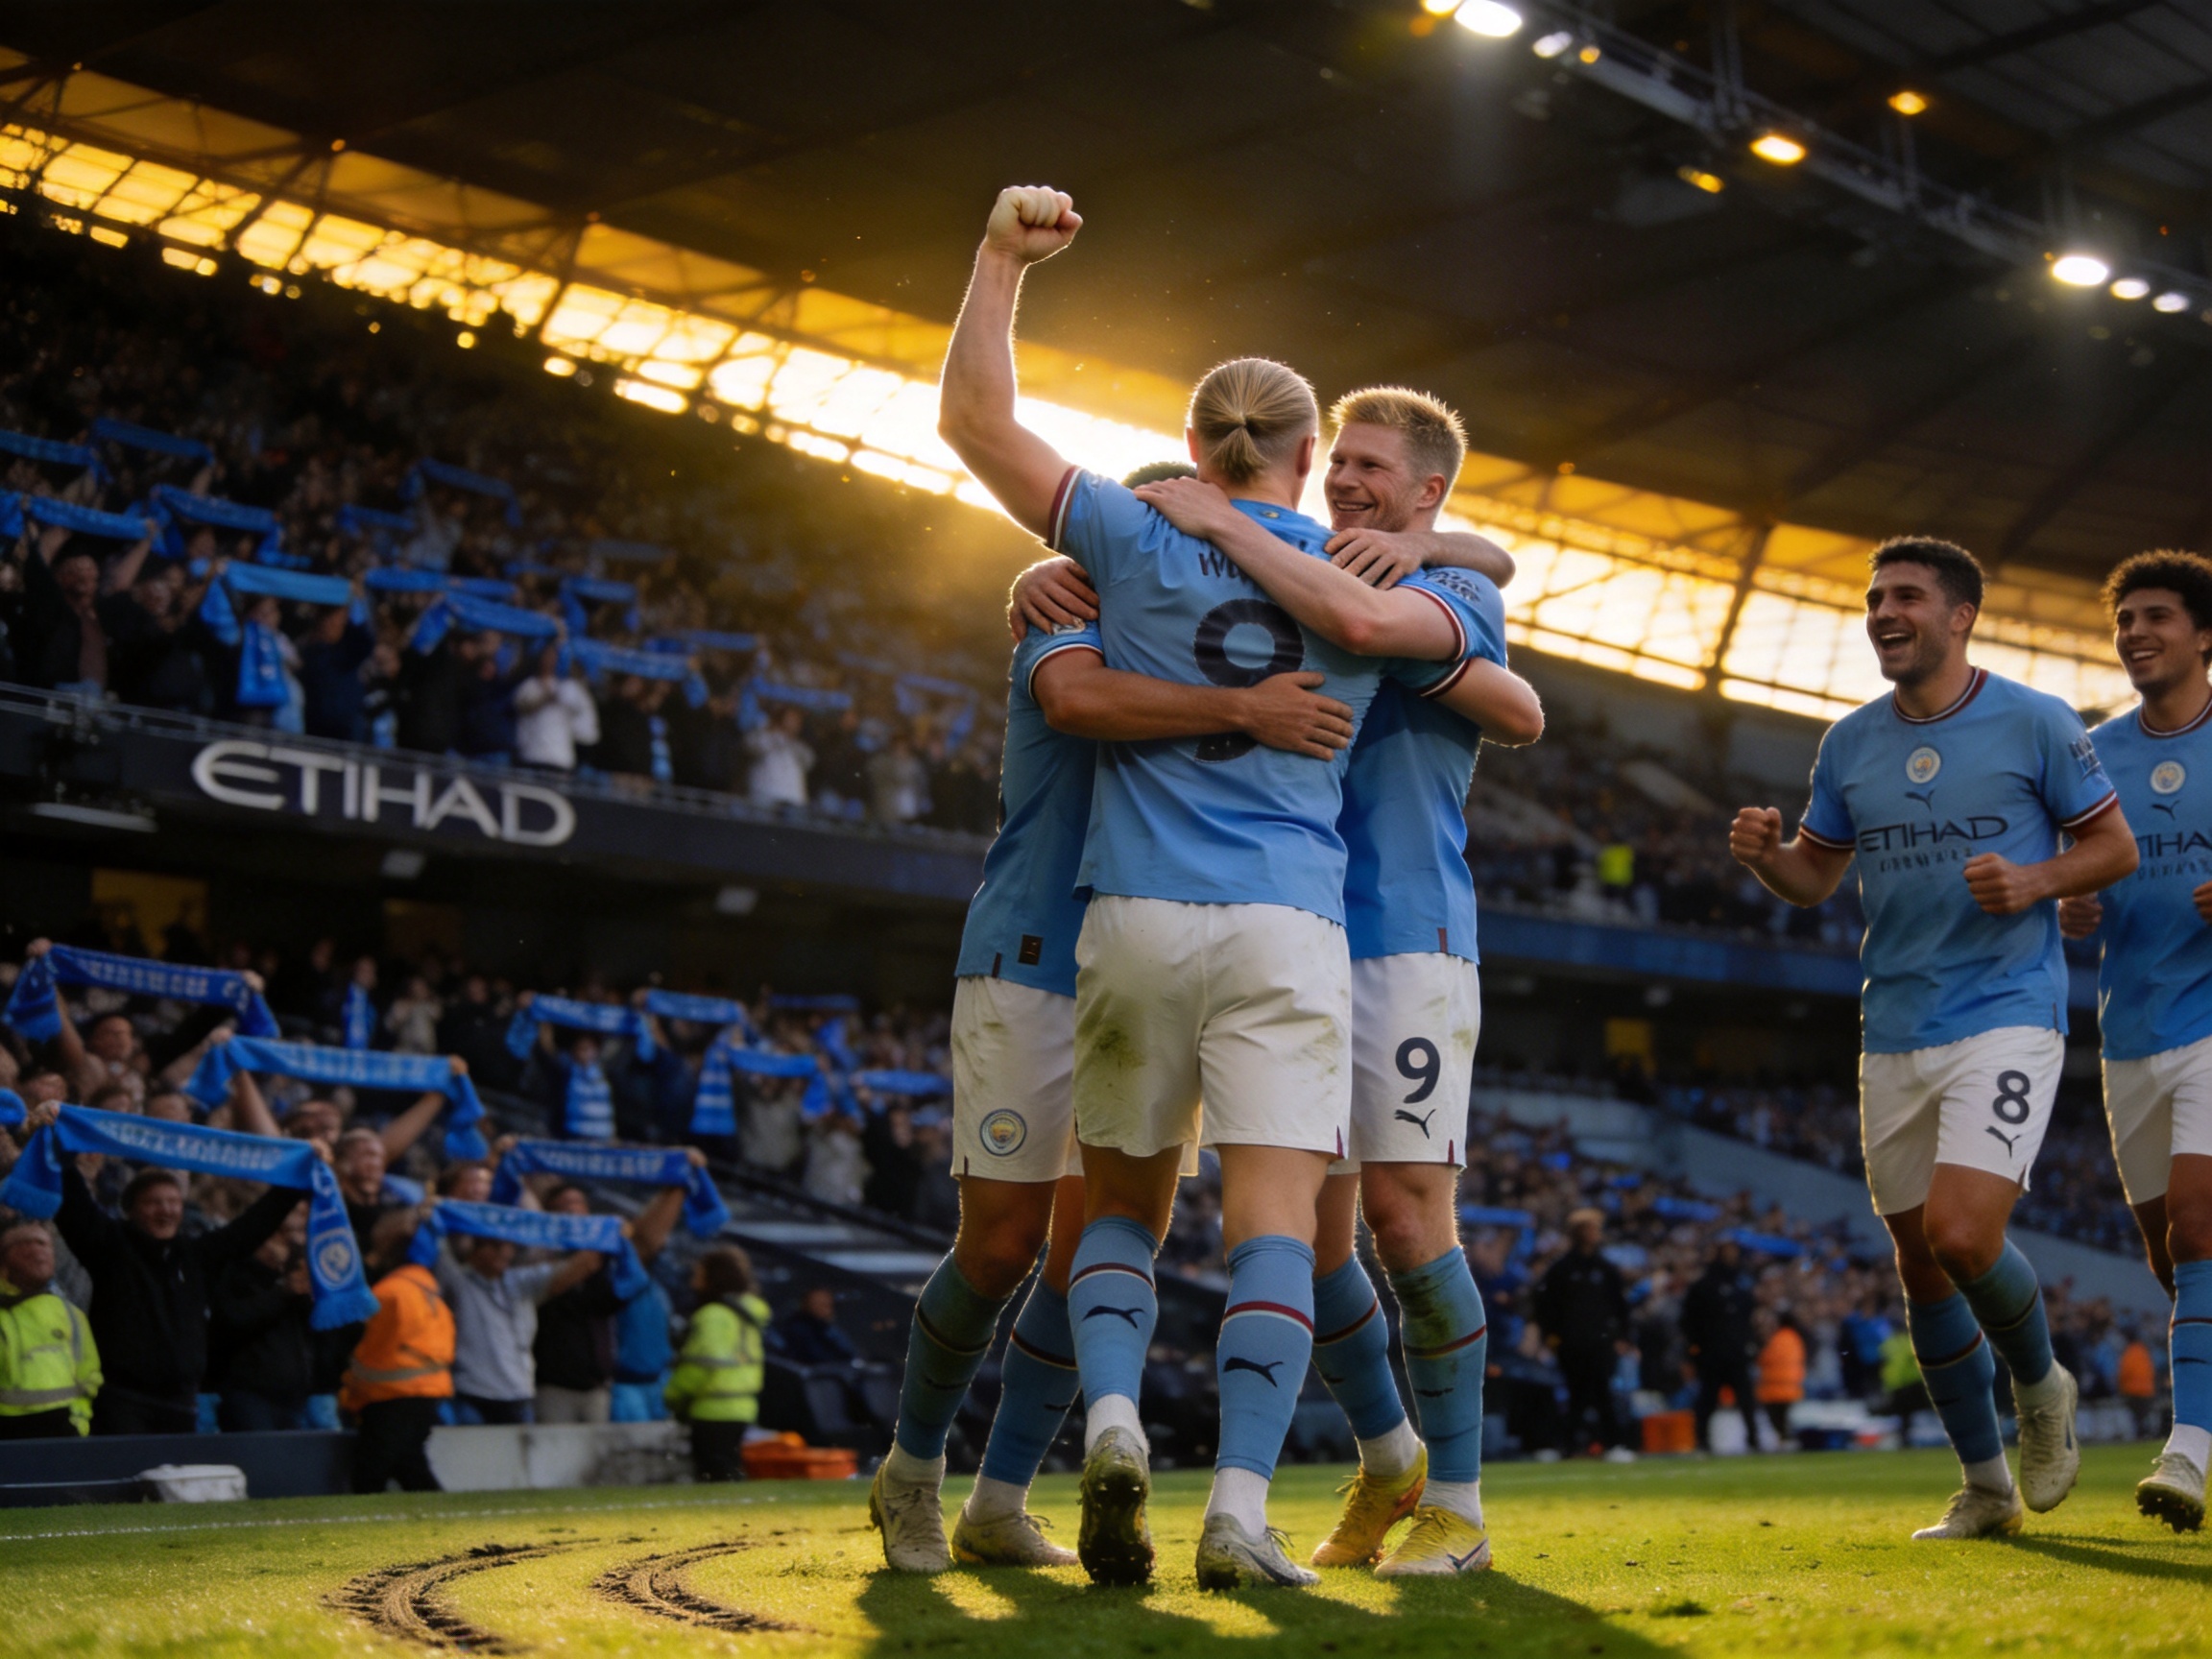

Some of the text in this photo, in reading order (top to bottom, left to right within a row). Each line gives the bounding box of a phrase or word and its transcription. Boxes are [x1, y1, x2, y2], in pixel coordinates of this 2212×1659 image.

[1193, 598, 1305, 762] 9
[191, 739, 575, 847] ETIHAD
[1859, 815, 2009, 853] ETIHAD
[1395, 1037, 1441, 1104] 9
[1992, 1070, 2031, 1125] 8
